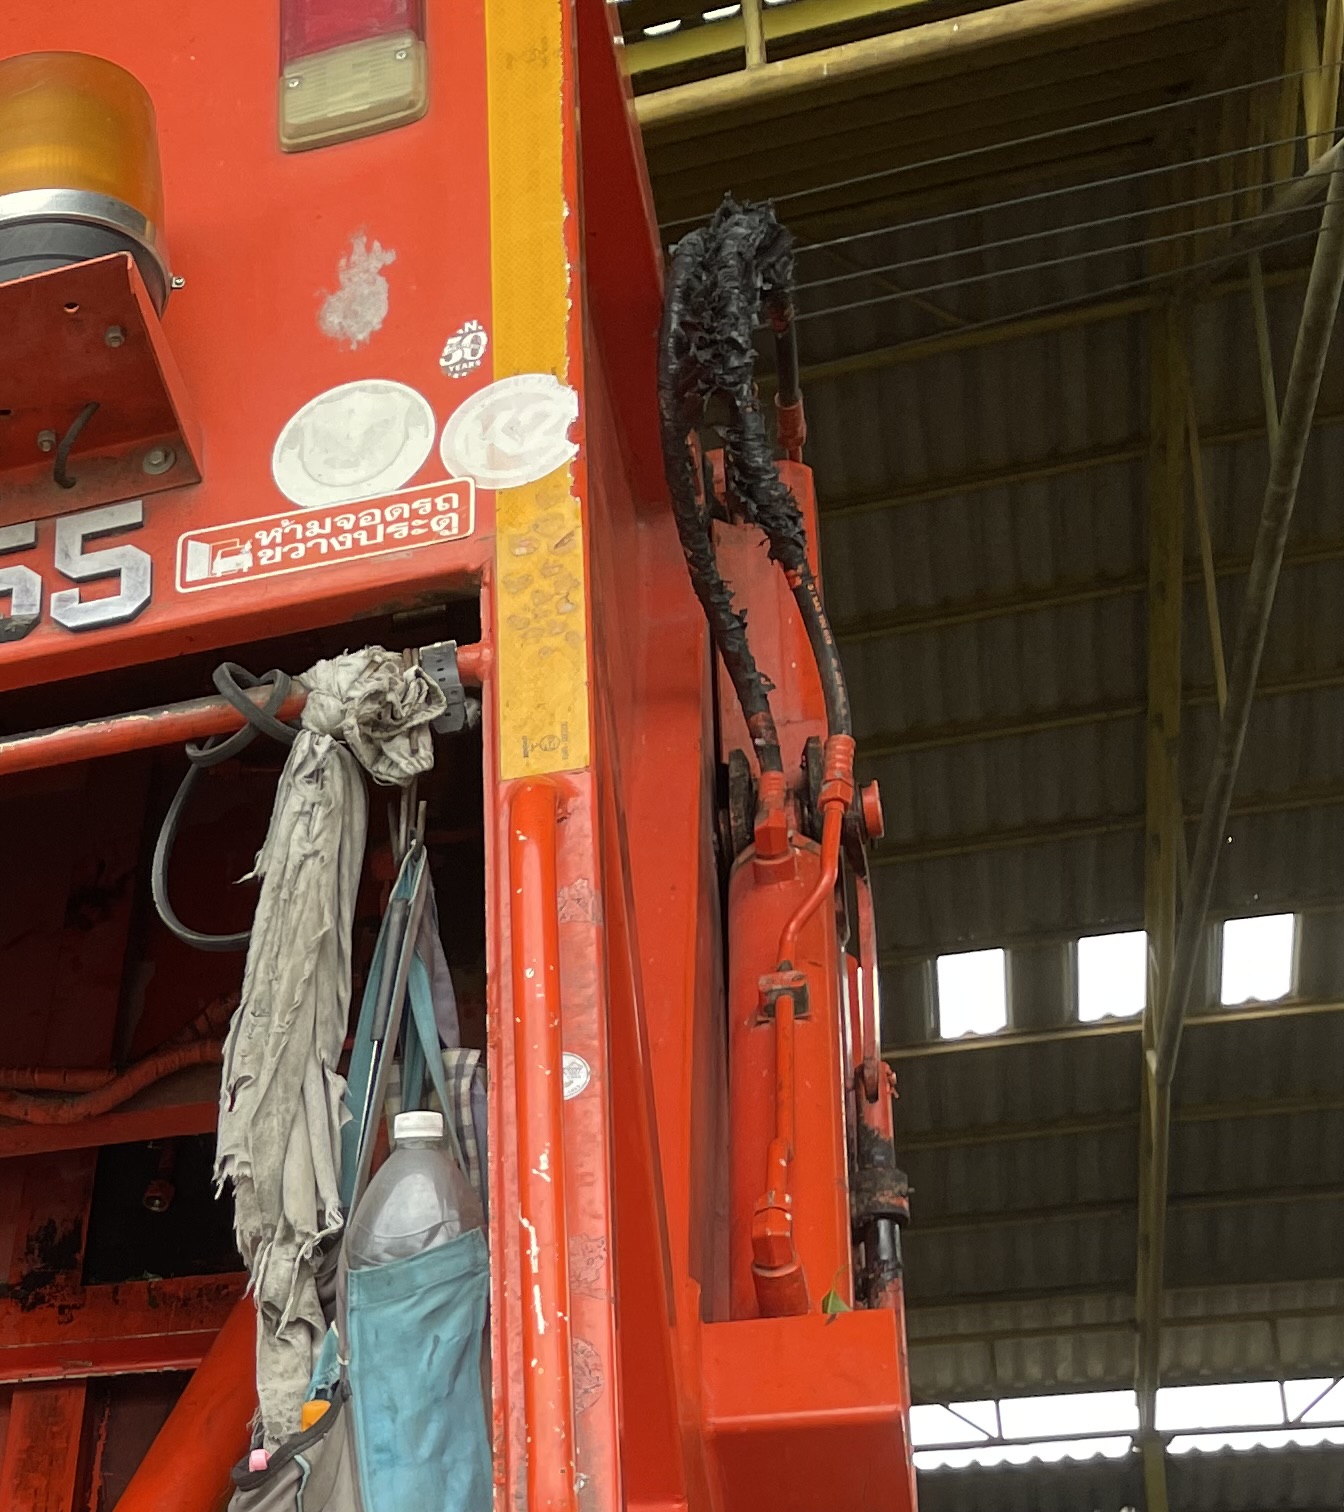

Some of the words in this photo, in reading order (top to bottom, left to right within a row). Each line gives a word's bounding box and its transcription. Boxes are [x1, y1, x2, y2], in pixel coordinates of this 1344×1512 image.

[440, 332, 488, 366] 50
[449, 360, 481, 372] YEARS
[256, 491, 459, 545] ห้ามจอดรถ
[257, 508, 459, 565] ขวางประตู
